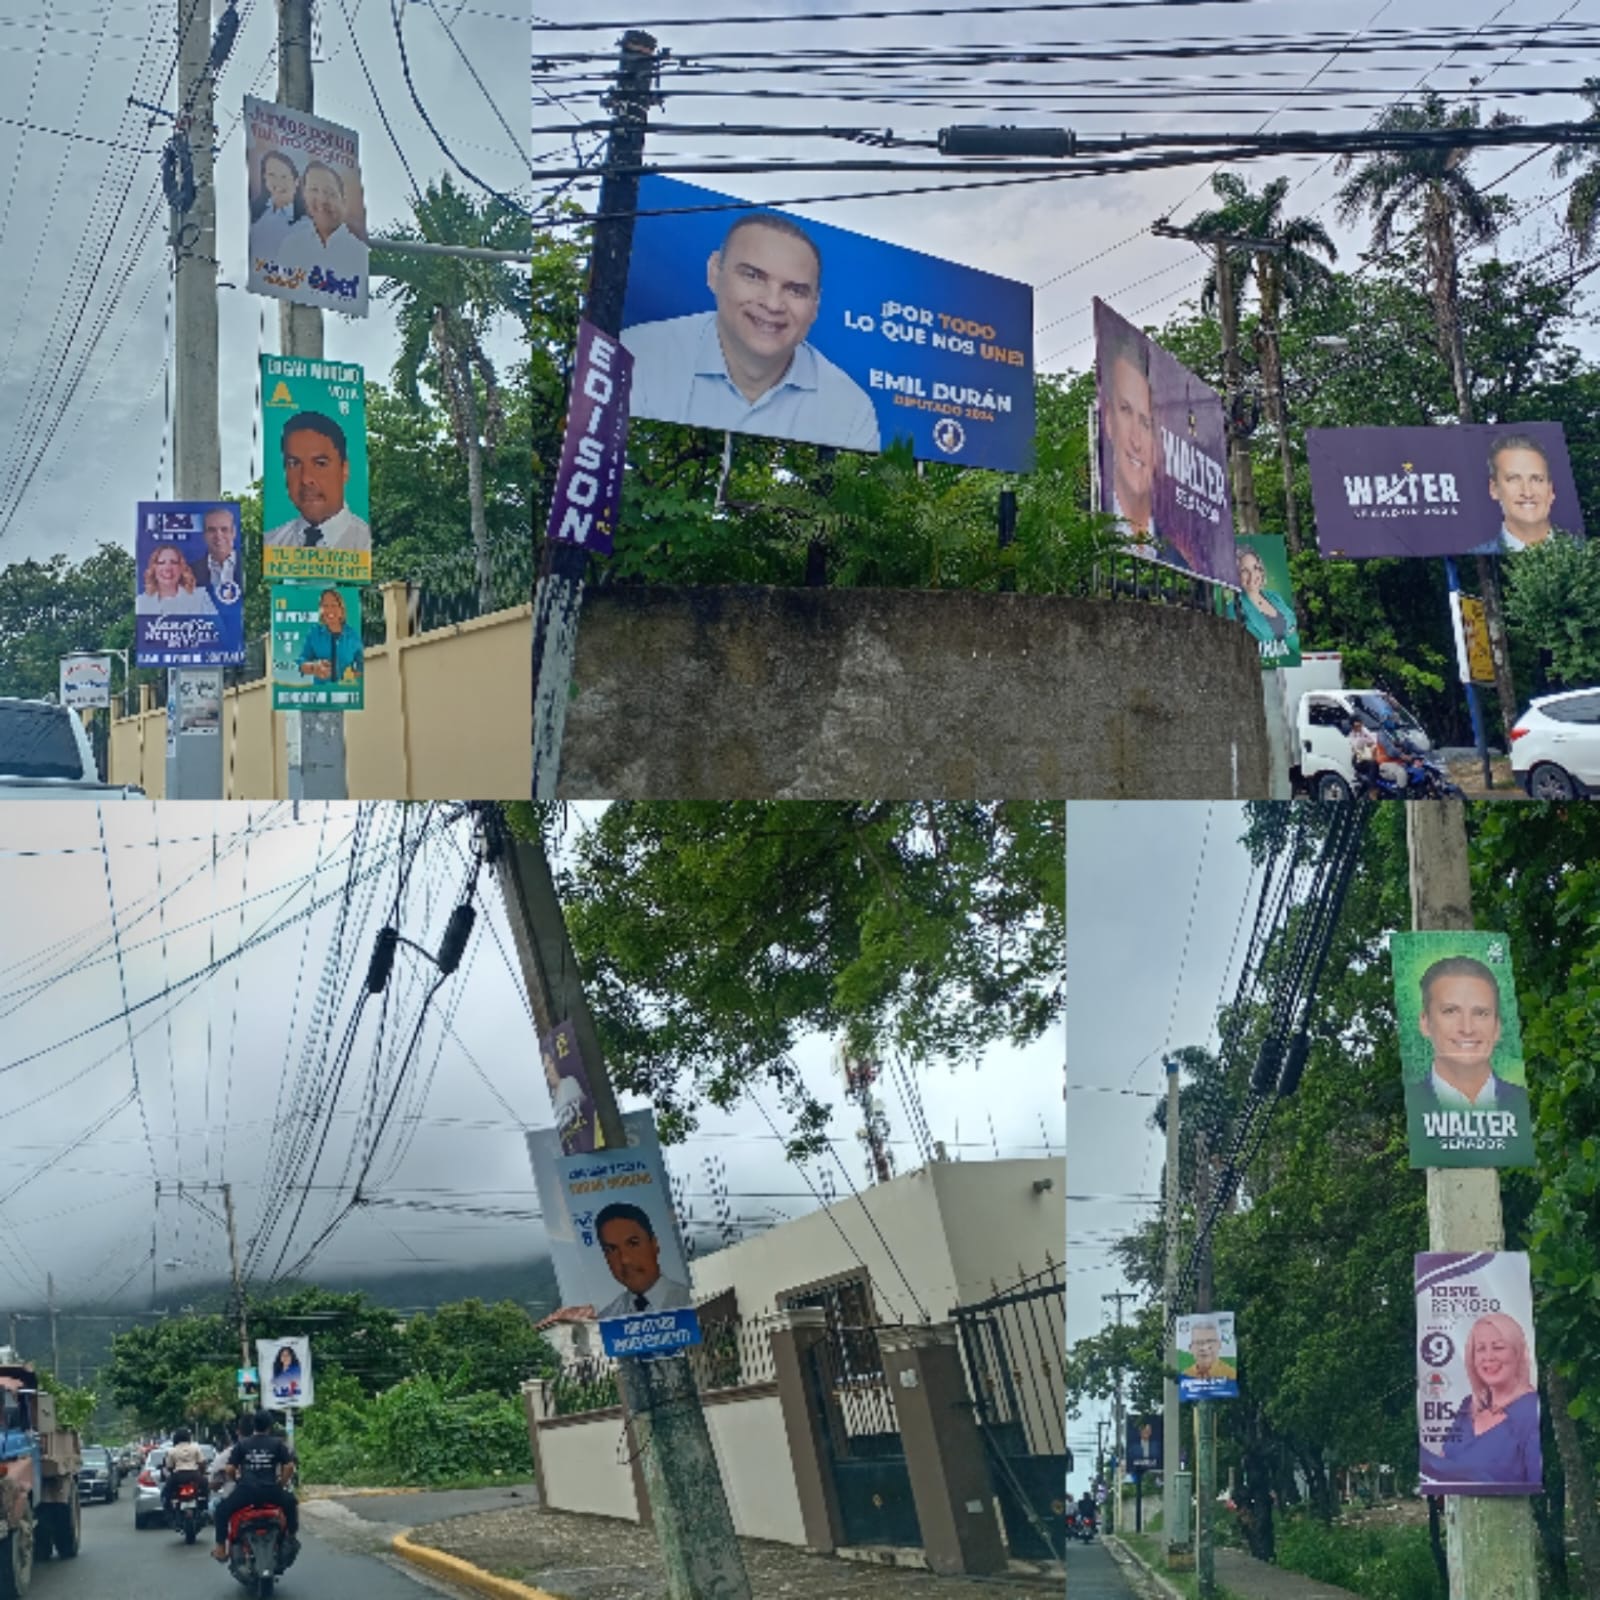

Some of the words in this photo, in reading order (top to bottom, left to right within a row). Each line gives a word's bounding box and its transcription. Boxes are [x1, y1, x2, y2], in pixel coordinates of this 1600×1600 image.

[844, 310, 875, 332] LO
[881, 321, 927, 344] QUE
[932, 332, 976, 355] NOS
[938, 313, 996, 340] TODO
[869, 368, 926, 397] EMIL
[932, 382, 1012, 412] DURÁN
[893, 394, 963, 416] DIPUTADO
[1160, 425, 1227, 509] WALTER
[1343, 472, 1461, 506] WALTER
[1422, 1109, 1518, 1139] WALTER
[1439, 1136, 1506, 1150] SENADOR
[1428, 1336, 1448, 1363] 9
